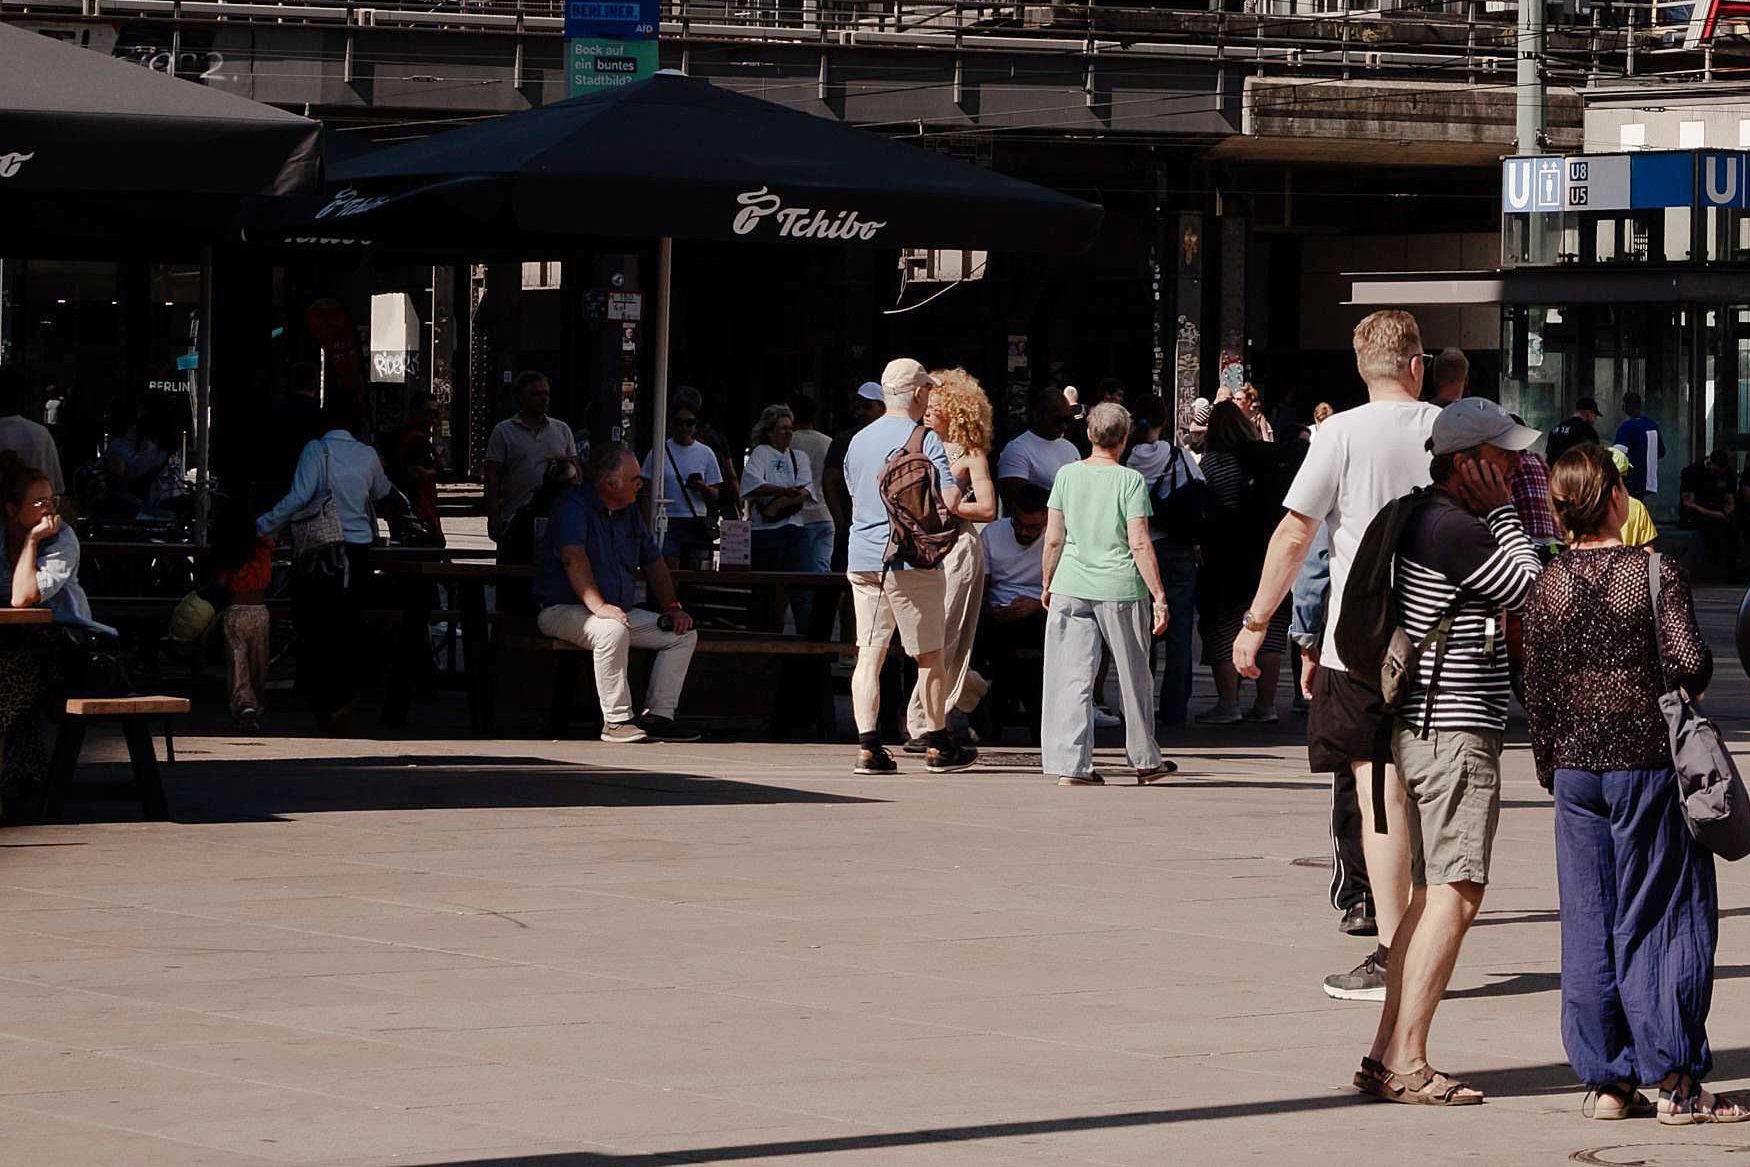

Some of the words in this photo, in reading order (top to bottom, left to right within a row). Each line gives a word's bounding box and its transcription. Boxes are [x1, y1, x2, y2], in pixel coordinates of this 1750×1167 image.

[572, 3, 638, 19] BERLINER.
[635, 25, 653, 33] AfD
[576, 44, 602, 55] Bock
[606, 44, 624, 55] auf
[575, 60, 592, 70] ein
[597, 58, 634, 71] buntes
[575, 74, 632, 86] Stadtbild?
[1508, 162, 1531, 209] U
[1570, 163, 1588, 180] U8
[1705, 156, 1737, 205] U
[1570, 187, 1588, 205] U5
[777, 208, 887, 240] Tchibo
